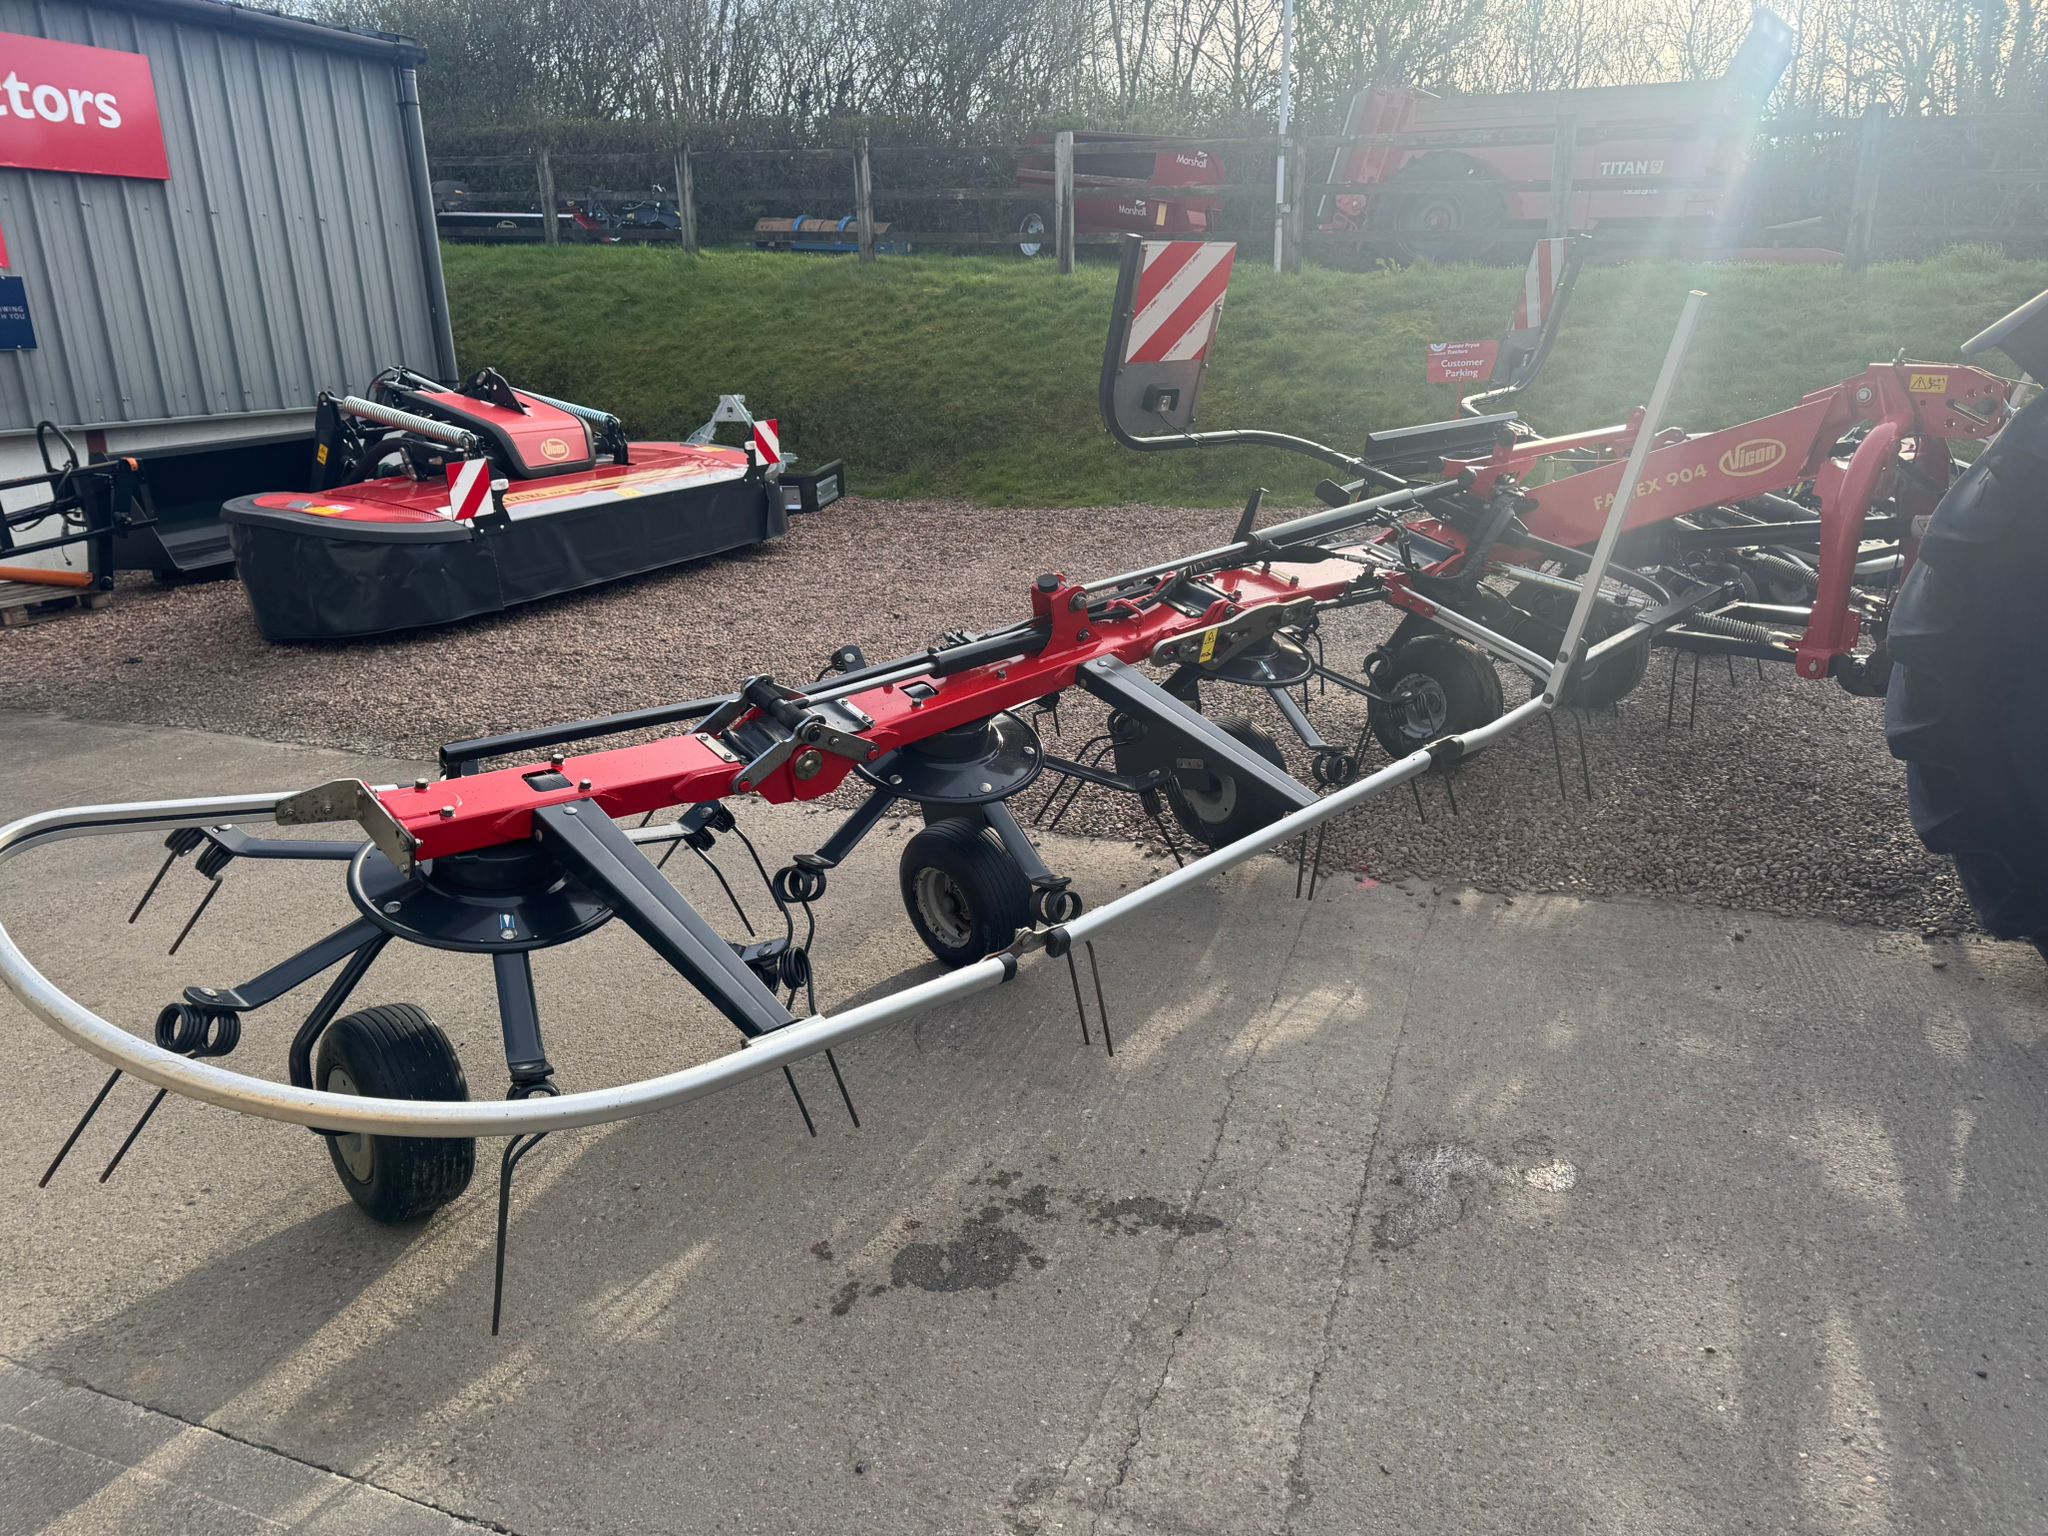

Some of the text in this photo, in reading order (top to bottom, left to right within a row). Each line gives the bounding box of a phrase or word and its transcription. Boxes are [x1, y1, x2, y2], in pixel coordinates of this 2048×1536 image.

[0, 70, 121, 129] tors
[1176, 154, 1207, 168] Marshall
[1601, 160, 1648, 175] TITAN
[1119, 205, 1146, 216] Marshall
[1441, 359, 1484, 368] Customer
[1445, 369, 1478, 378] Parking
[1726, 443, 1778, 470] Vicon
[1593, 463, 1708, 511] FAEX 904
